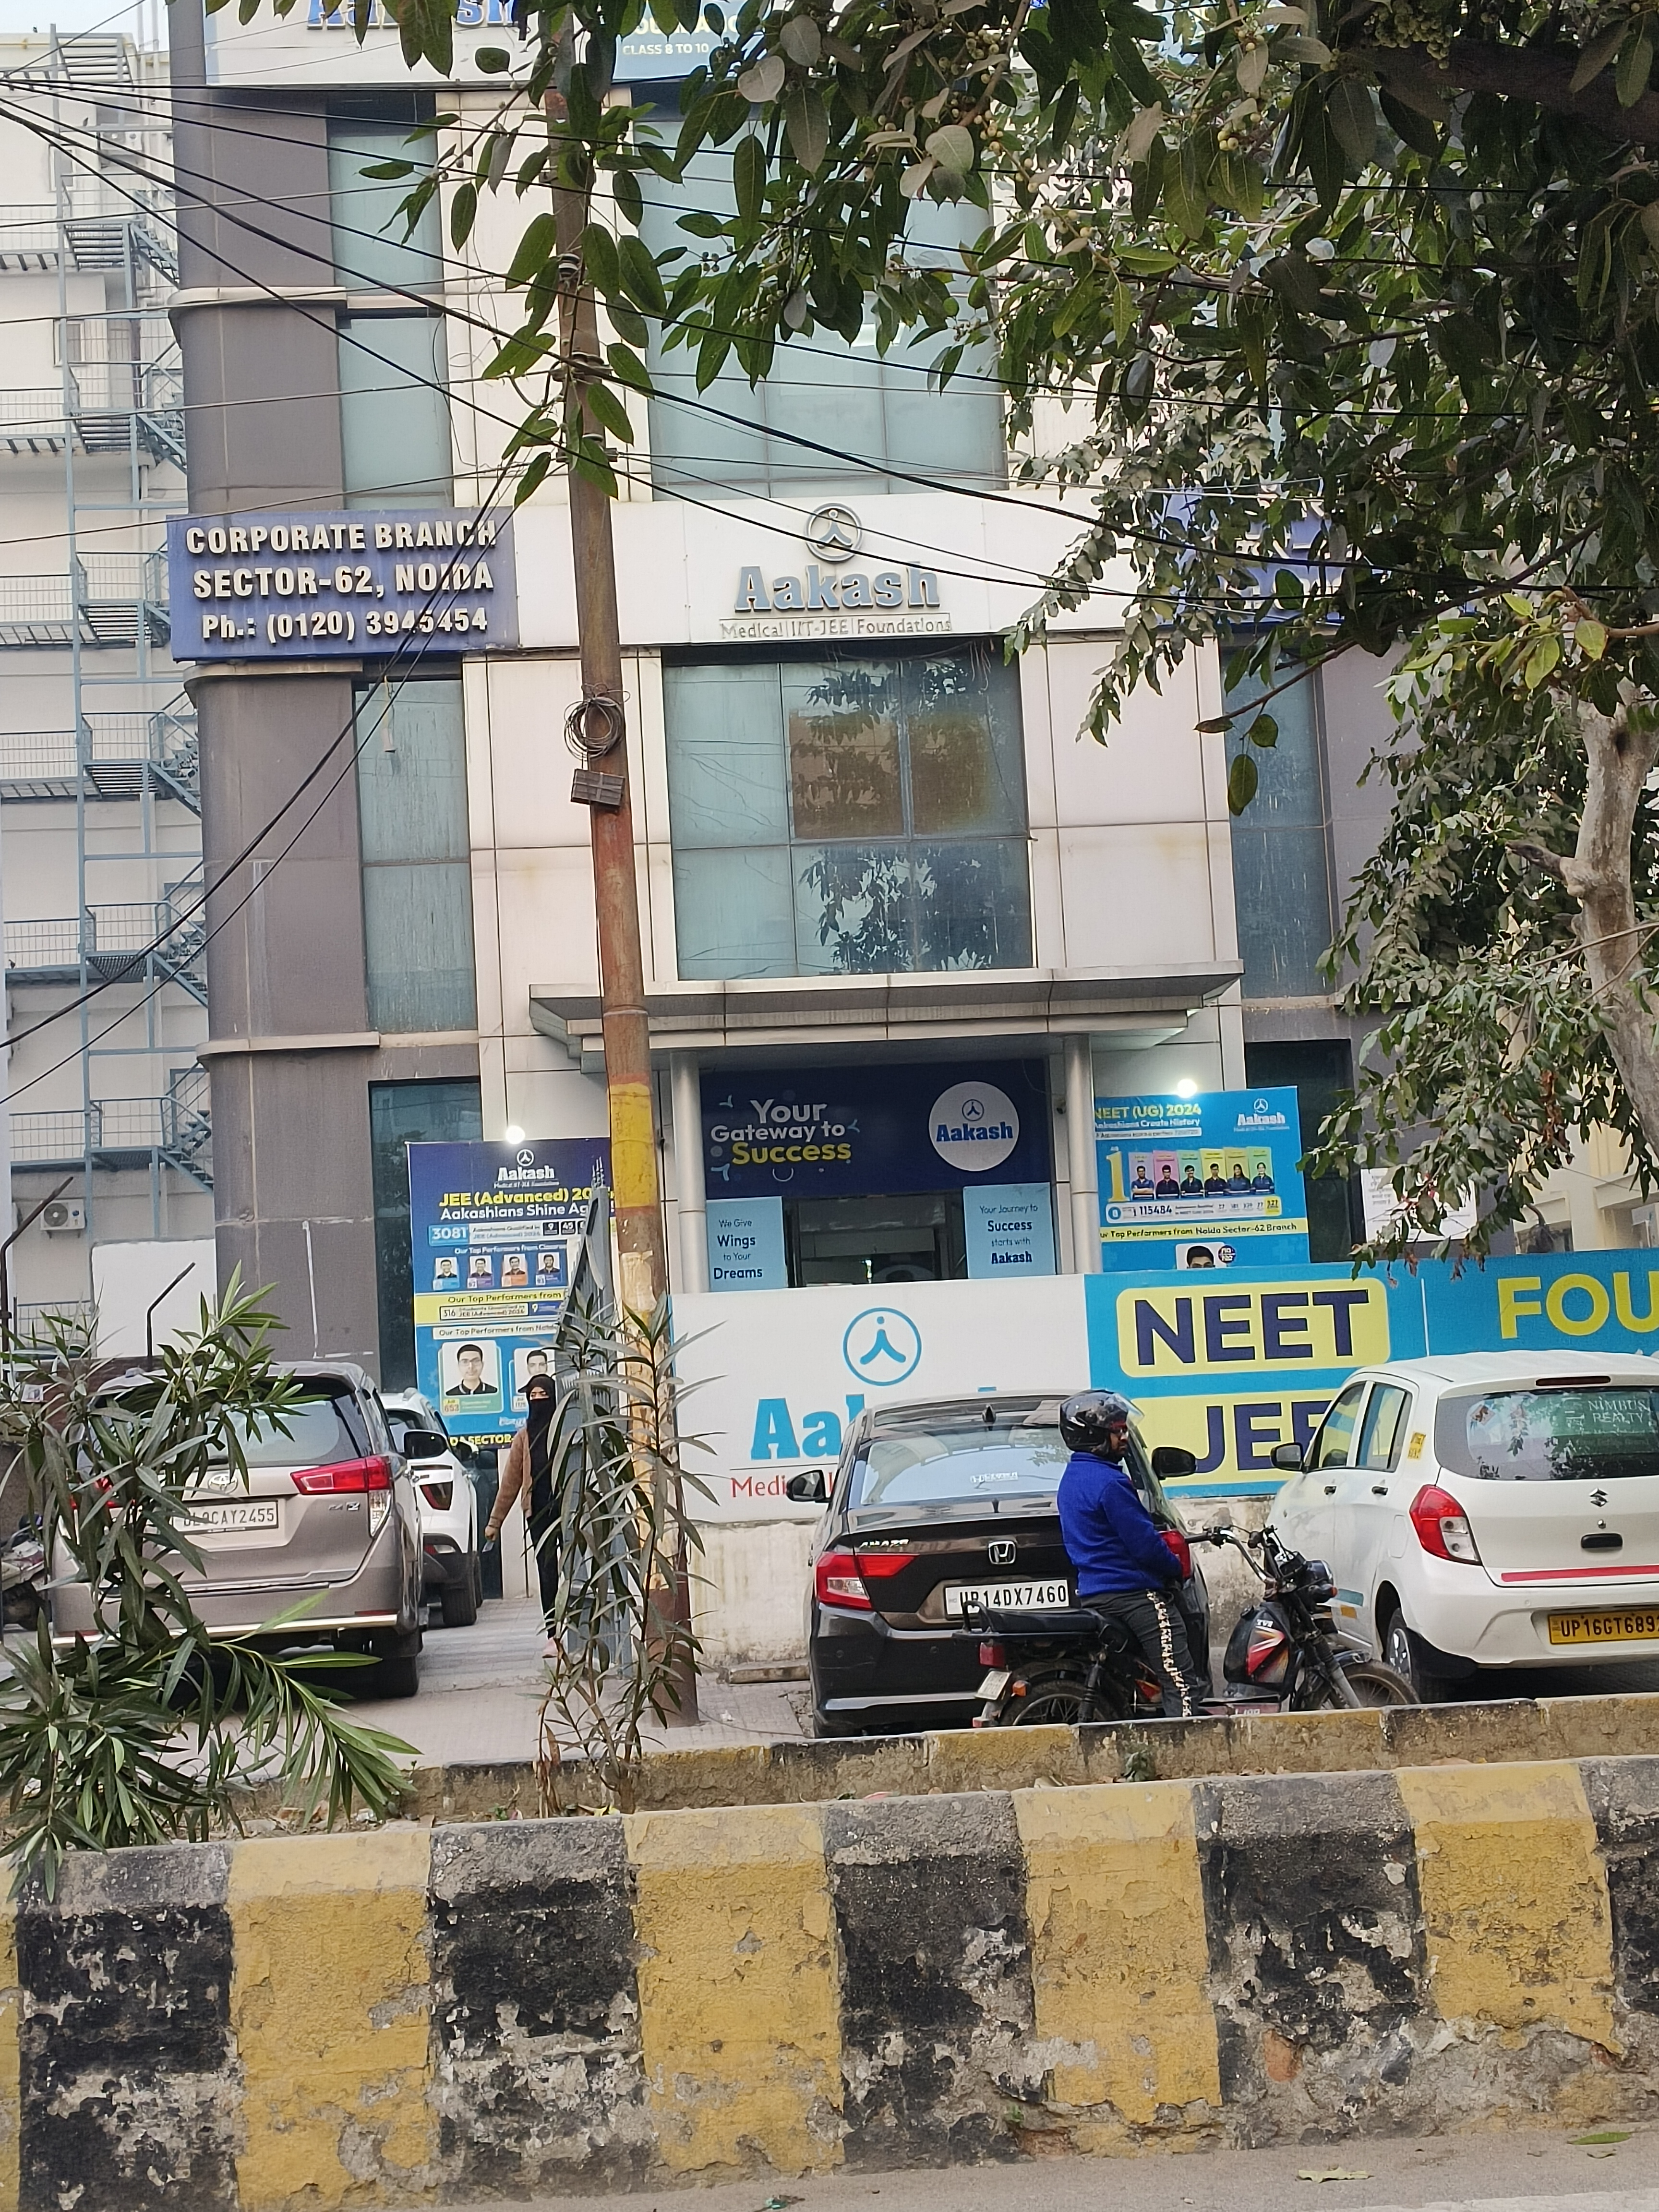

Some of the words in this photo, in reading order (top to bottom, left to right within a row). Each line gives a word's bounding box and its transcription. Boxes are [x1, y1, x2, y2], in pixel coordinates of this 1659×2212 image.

[623, 44, 661, 55] CLASS
[665, 44, 673, 54] 8
[675, 43, 693, 53] TO
[695, 43, 709, 53] 10
[187, 523, 366, 553] CORPORATE
[376, 519, 497, 549] BRANCH
[193, 565, 385, 598] SECTOR-62,
[396, 561, 494, 591] NOIDA
[735, 561, 941, 612] Aakash
[267, 611, 355, 643] (0120)
[366, 607, 487, 635] 3945454
[750, 1098, 828, 1124] Your
[1133, 1104, 1164, 1119] (UG)
[1166, 1103, 1202, 1117] 2024
[711, 1124, 817, 1142] Gateway
[820, 1120, 845, 1137] to
[936, 1122, 1014, 1142] Aakash
[732, 1142, 852, 1165] Success
[498, 1165, 555, 1181] Aakash
[439, 1192, 472, 1207] JEE
[474, 1187, 569, 1207] (Advanced)
[440, 1204, 523, 1220] Aakashians
[527, 1203, 565, 1216] Shine
[979, 1205, 997, 1214] Your
[1030, 1203, 1038, 1212] to
[987, 1220, 1033, 1232] Success
[1267, 1222, 1297, 1232] Branch
[717, 1234, 756, 1249] Wings
[733, 1252, 751, 1261] Your
[991, 1250, 1032, 1264] Aakash
[714, 1267, 763, 1280] Dreams
[469, 1295, 484, 1304] Top
[1134, 1289, 1370, 1366] NEET
[1561, 1615, 1659, 1637] UP16GT689
